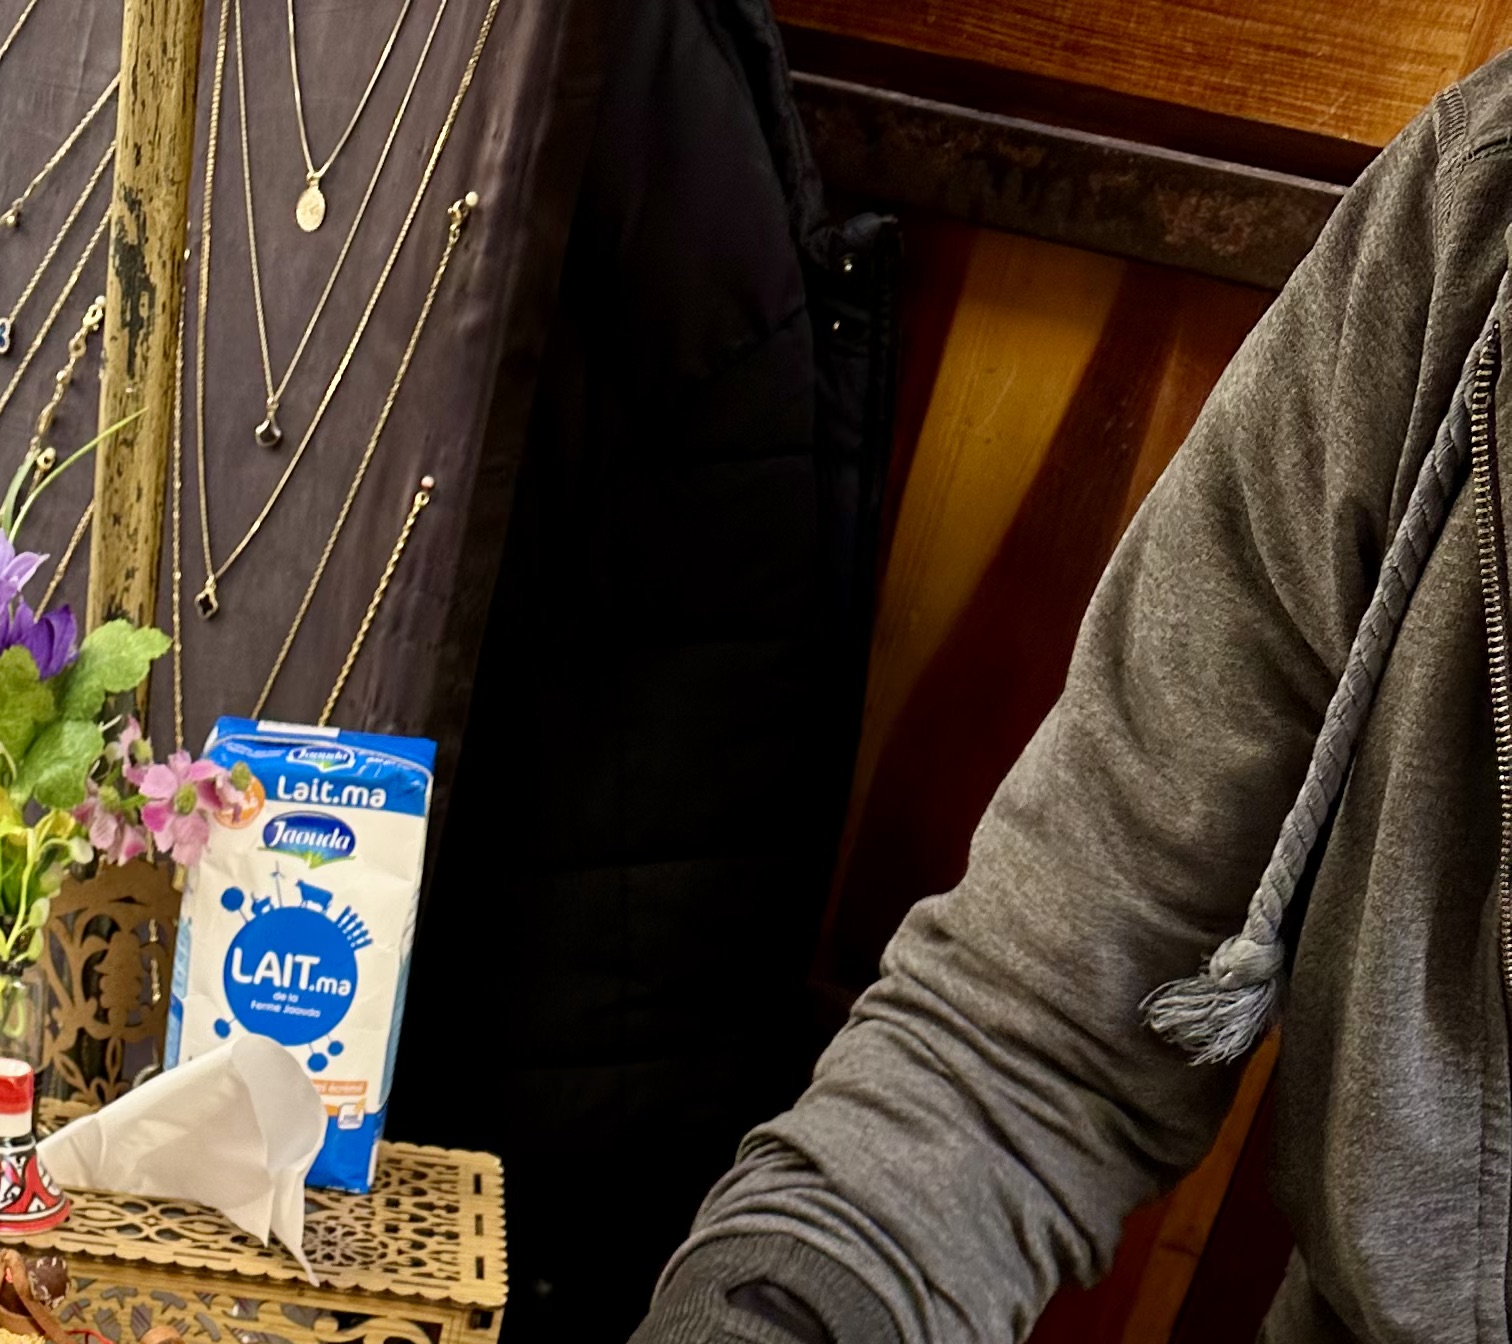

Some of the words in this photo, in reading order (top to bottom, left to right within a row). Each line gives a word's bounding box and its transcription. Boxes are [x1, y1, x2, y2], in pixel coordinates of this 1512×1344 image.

[276, 775, 387, 808] Lait.ma
[268, 821, 352, 851] Jaouda
[231, 946, 352, 997] LAIT.ma
